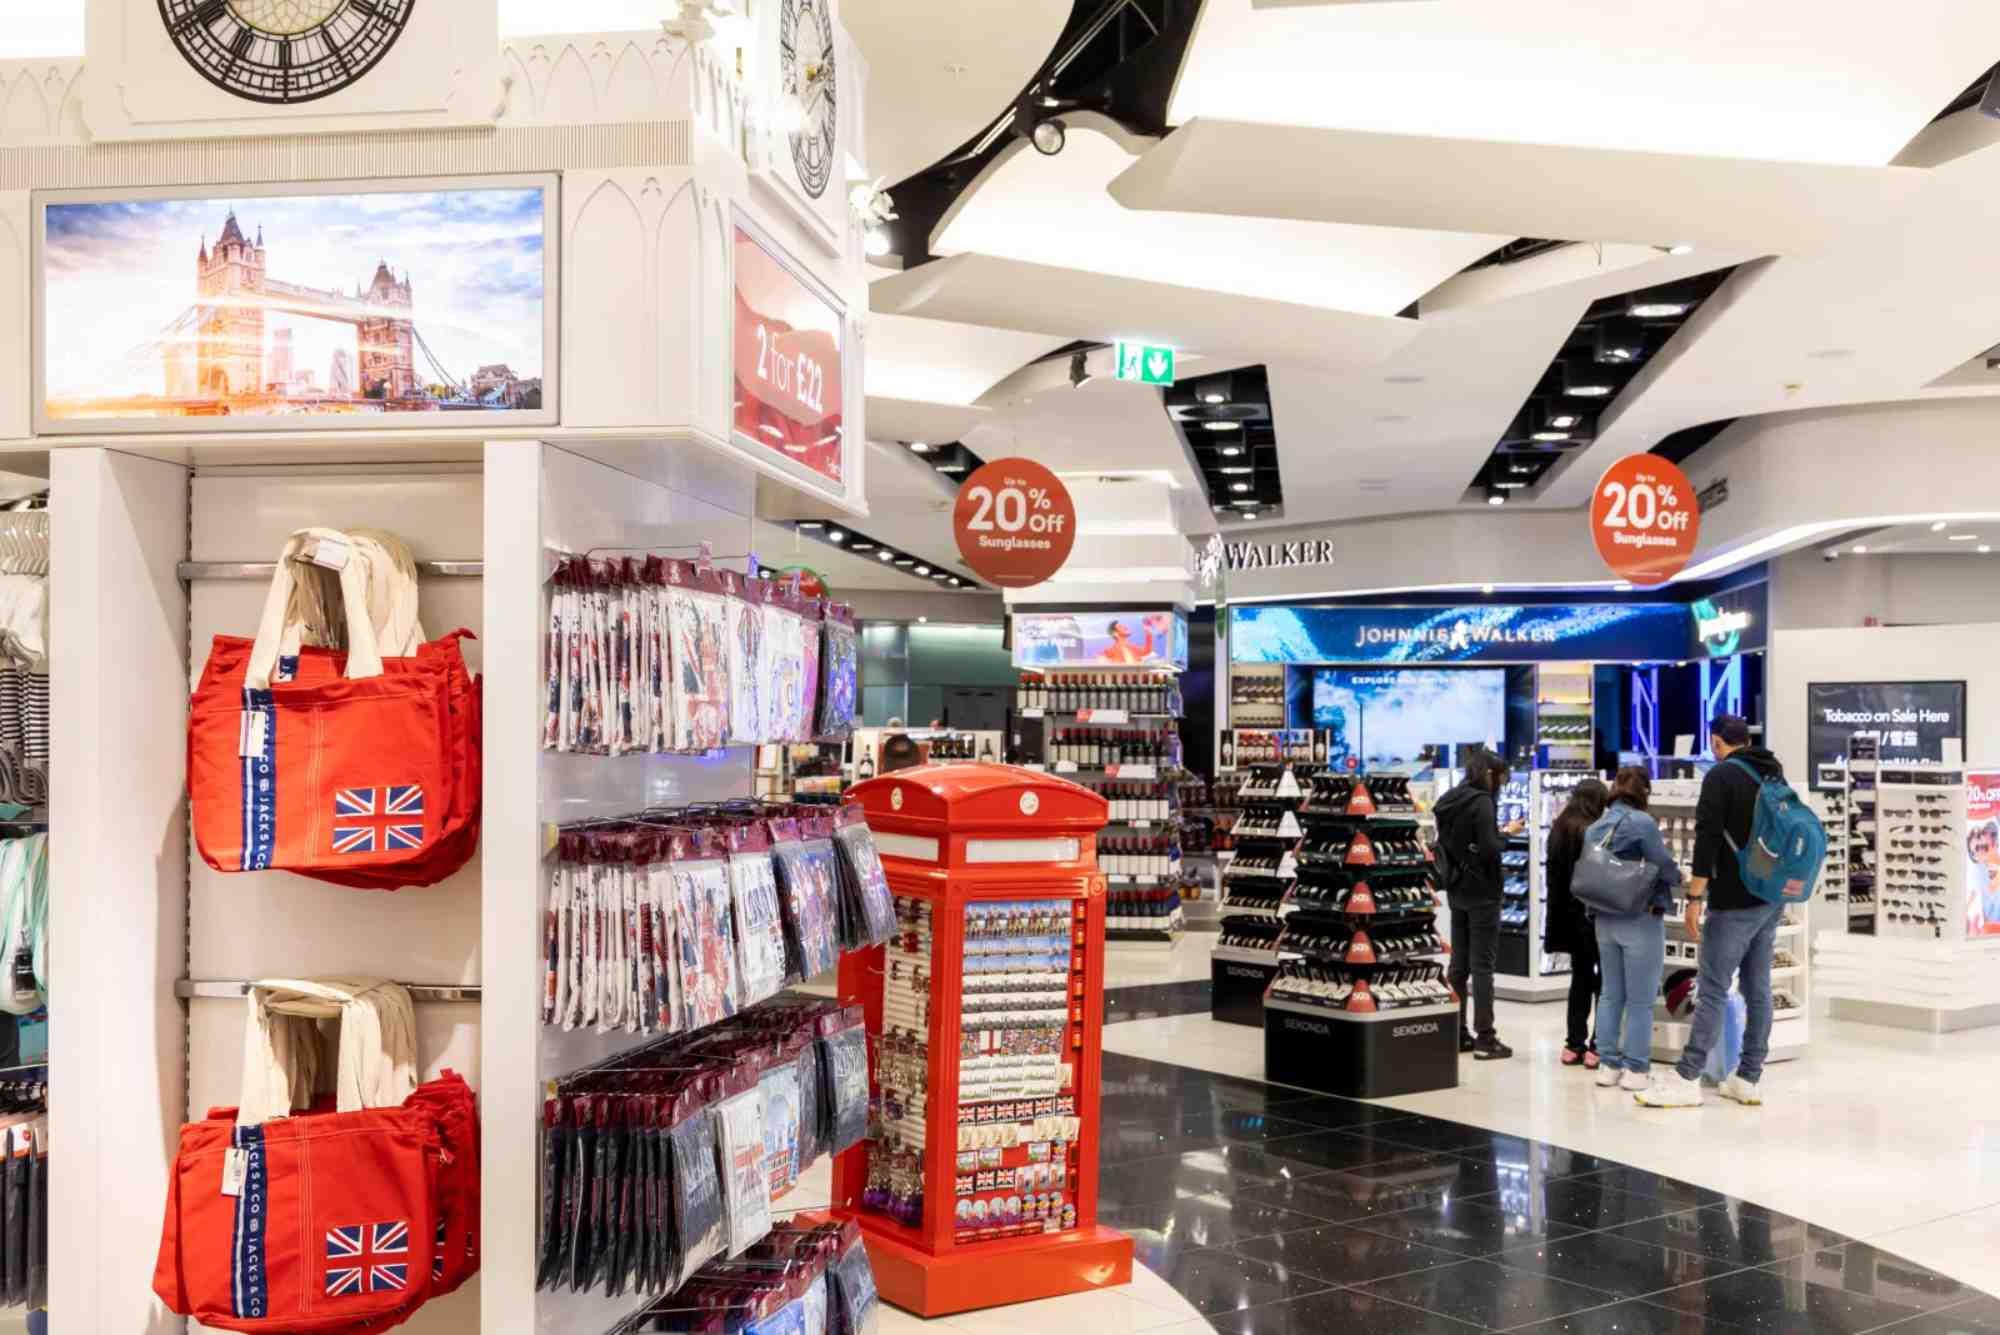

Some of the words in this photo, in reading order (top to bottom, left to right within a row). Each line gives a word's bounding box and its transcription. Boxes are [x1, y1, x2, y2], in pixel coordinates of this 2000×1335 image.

[757, 323, 767, 380] 2
[770, 332, 794, 393] for
[796, 351, 823, 415] £22
[1029, 514, 1064, 533] Off
[1657, 511, 1688, 530] Off
[979, 535, 1051, 551] Sunglasses
[1613, 531, 1677, 548] Sunglasses
[1224, 540, 1334, 571] WALKER
[1356, 625, 1448, 647] JOHNNIE
[1471, 627, 1557, 642] WALKER
[1824, 709, 1872, 723] Tobacco
[1873, 713, 1890, 723] on
[1891, 709, 1918, 723] Sale
[1919, 708, 1950, 723] Here
[1392, 1022, 1438, 1037] SEKONDA
